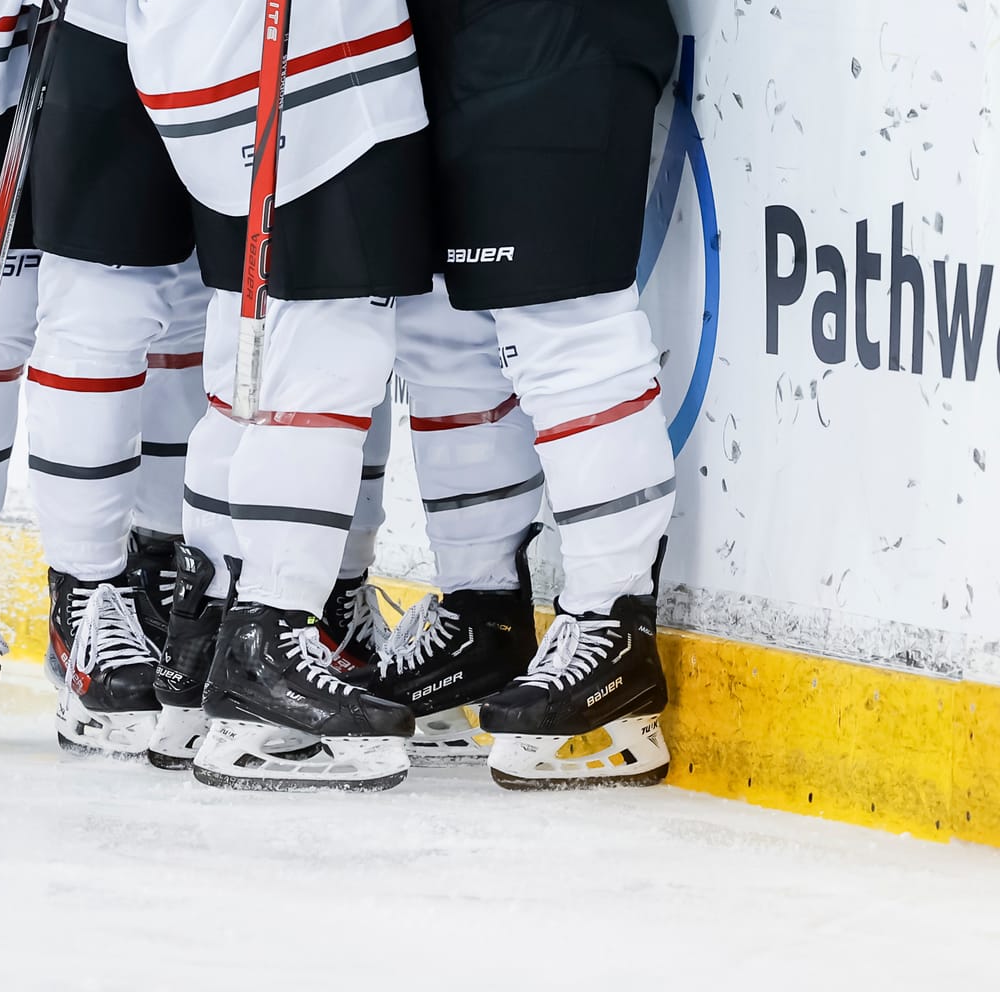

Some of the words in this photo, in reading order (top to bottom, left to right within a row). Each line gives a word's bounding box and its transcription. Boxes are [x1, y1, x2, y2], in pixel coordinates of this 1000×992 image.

[447, 246, 515, 263] BAUER
[765, 202, 1000, 381] Pathw
[412, 671, 464, 701] BAUER
[586, 676, 624, 708] BAUER
[641, 721, 660, 736] TUK
